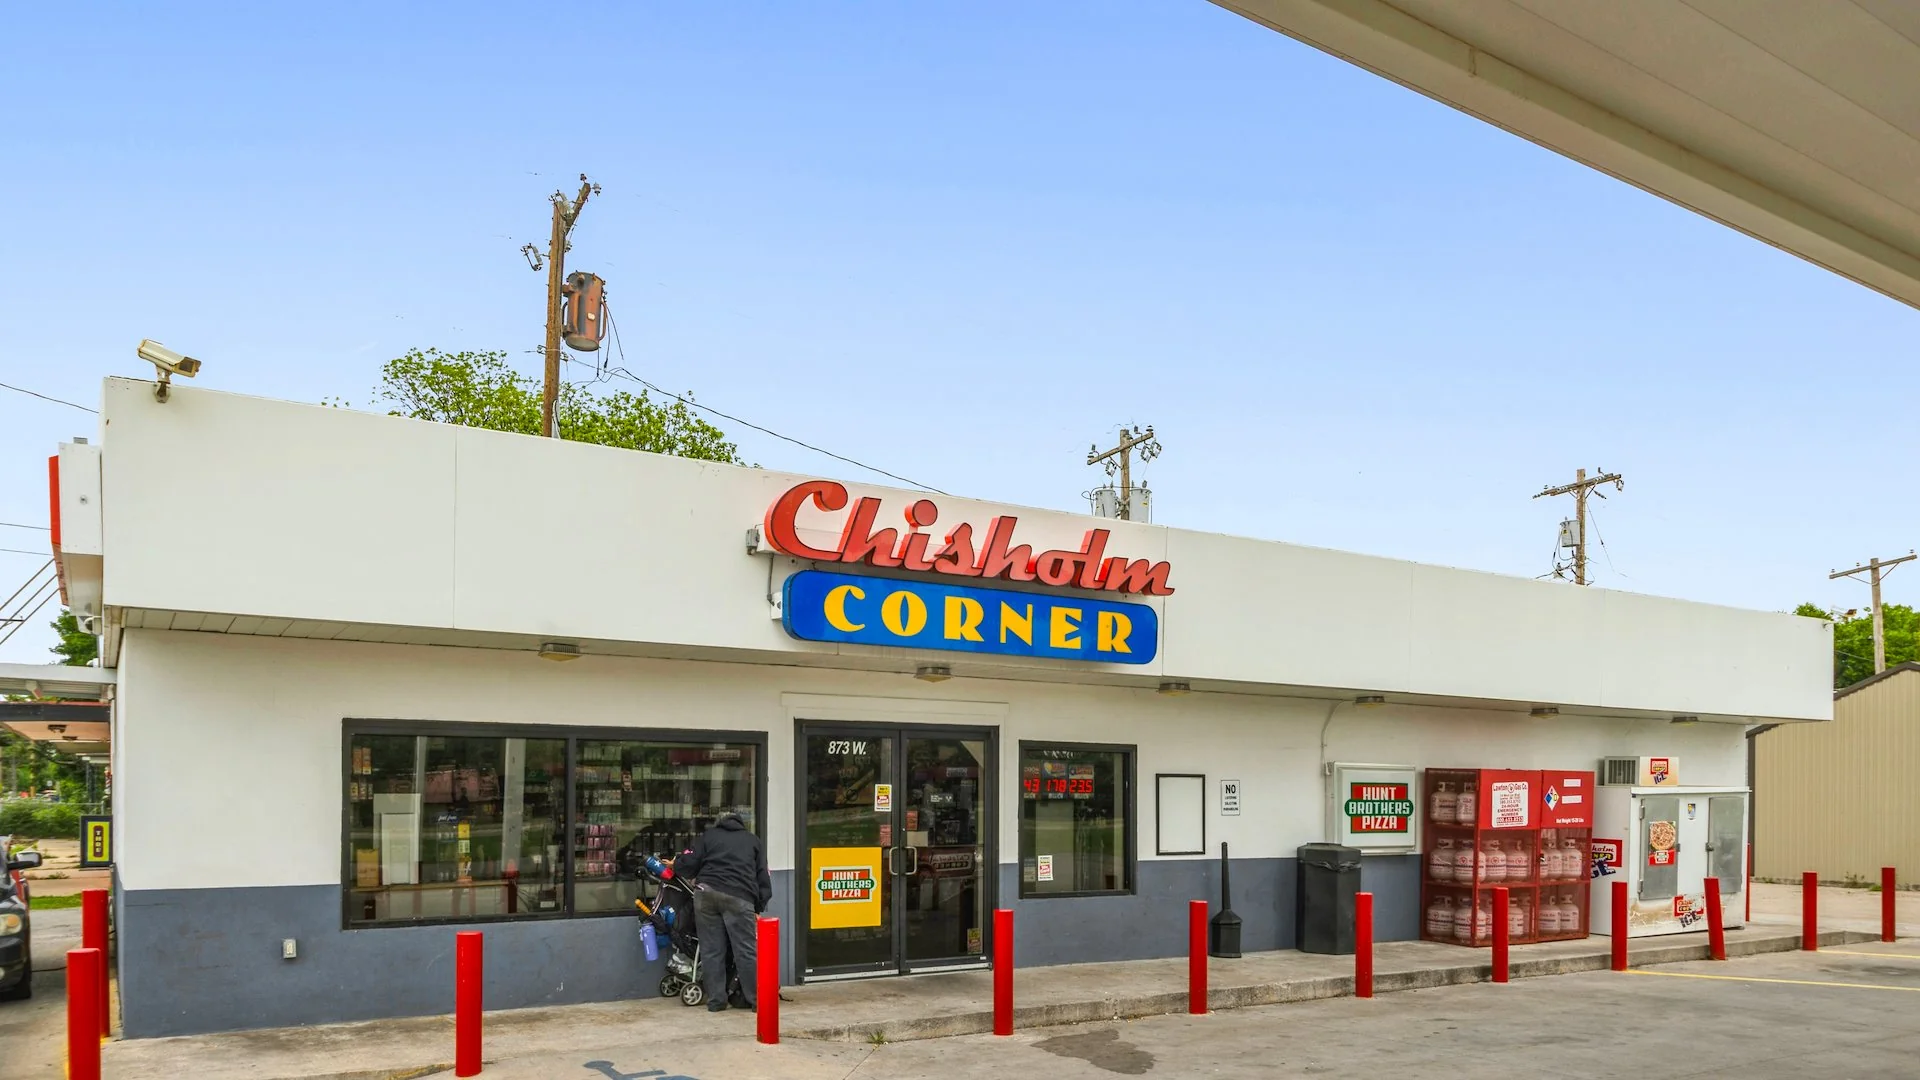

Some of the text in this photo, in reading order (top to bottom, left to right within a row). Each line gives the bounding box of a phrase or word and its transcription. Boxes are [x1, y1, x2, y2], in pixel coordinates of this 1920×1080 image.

[765, 480, 1175, 596] Chisholm
[823, 584, 1132, 654] CORNER
[828, 741, 867, 755] 873 W.
[1653, 772, 1667, 784] ICE
[1046, 779, 1067, 793] 178
[1069, 779, 1093, 793] 235
[1225, 784, 1236, 794] NO
[1362, 786, 1397, 800] HUNT
[1349, 800, 1410, 814] BROTHERS
[1362, 816, 1397, 829] PIZZA
[1592, 844, 1614, 853] holm
[1591, 856, 1616, 879] CE
[832, 871, 860, 880] HUNT
[821, 879, 872, 889] BROTHERS
[831, 889, 861, 898] PIZZA
